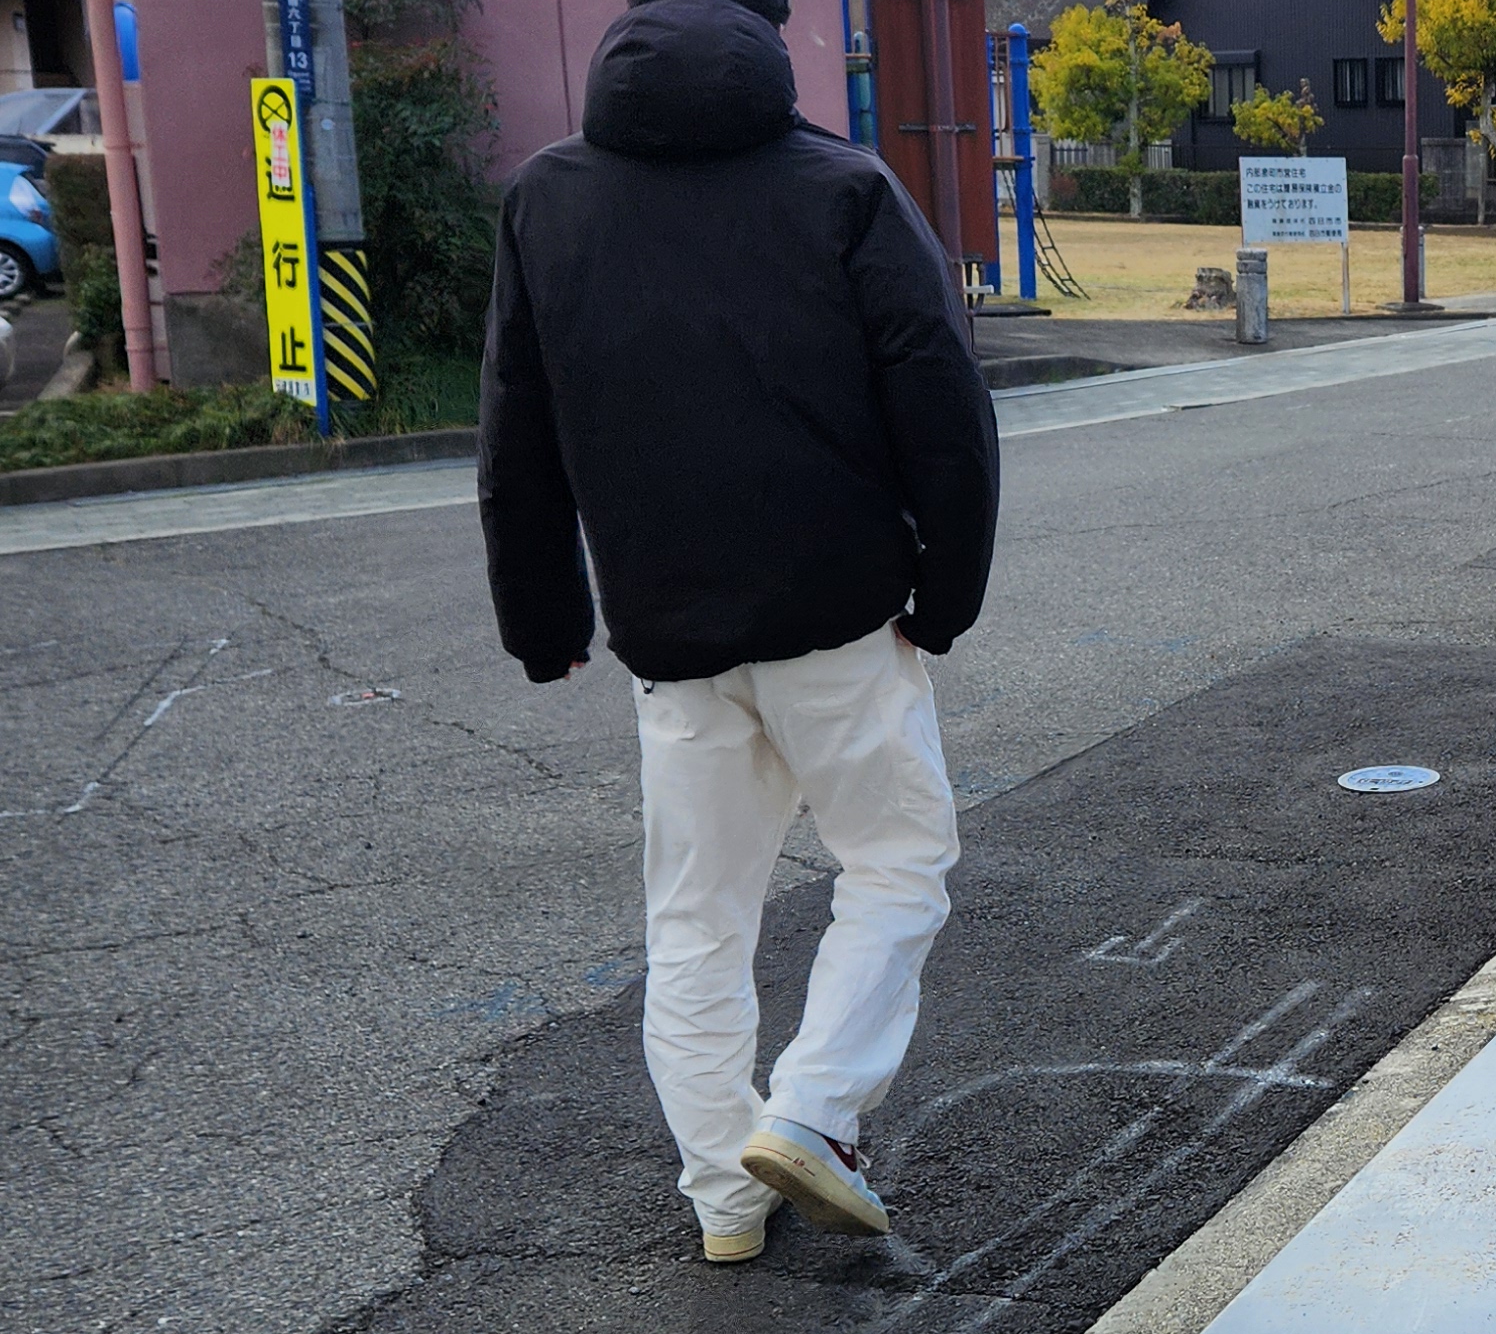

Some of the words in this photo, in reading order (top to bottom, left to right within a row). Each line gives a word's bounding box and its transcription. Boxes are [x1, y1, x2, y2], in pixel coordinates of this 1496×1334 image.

[288, 51, 308, 69] 13
[272, 124, 288, 179] 休工中
